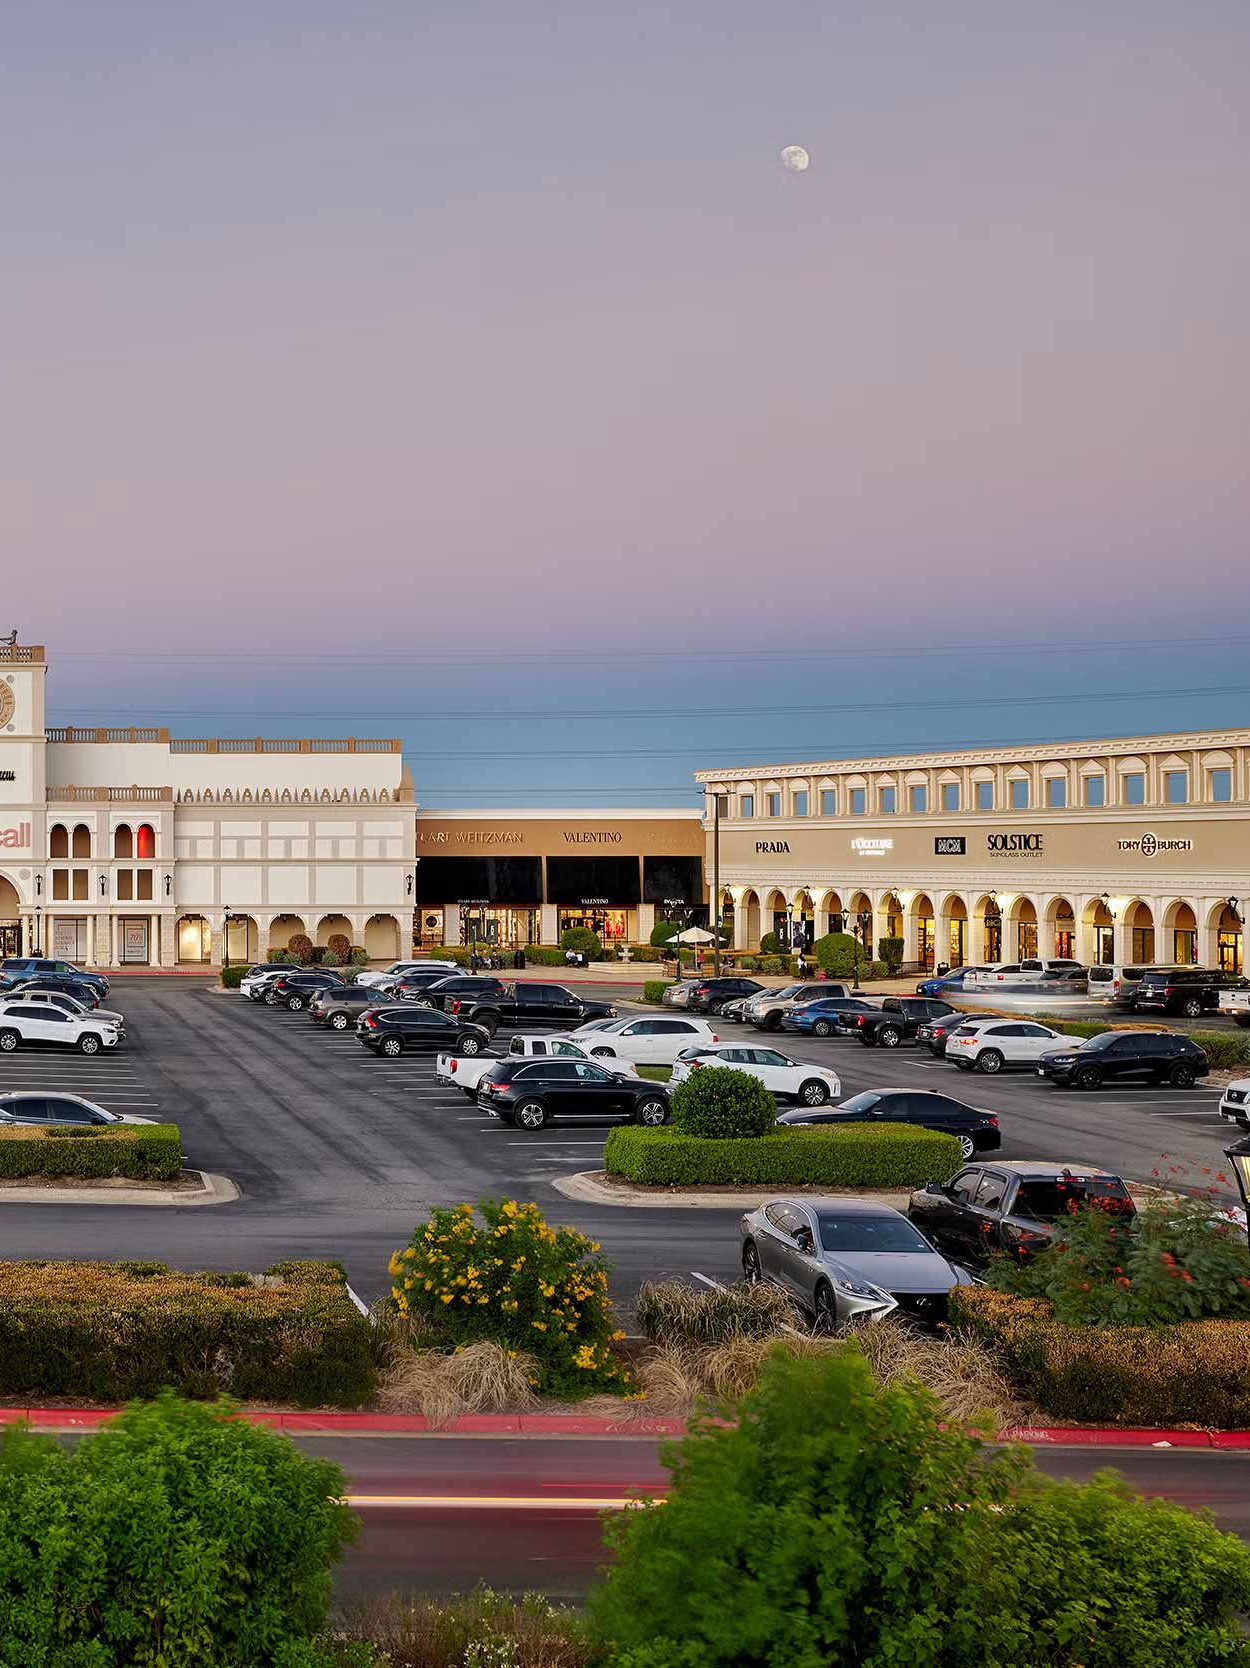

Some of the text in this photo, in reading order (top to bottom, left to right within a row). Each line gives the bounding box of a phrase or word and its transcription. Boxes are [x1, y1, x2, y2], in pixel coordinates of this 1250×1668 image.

[455, 832, 523, 843] WEITZMAN
[563, 832, 622, 843] VALENTINO
[988, 834, 1044, 850] SOLSTICE
[755, 841, 790, 853] PRADA
[1117, 840, 1192, 850] TORY BURCH
